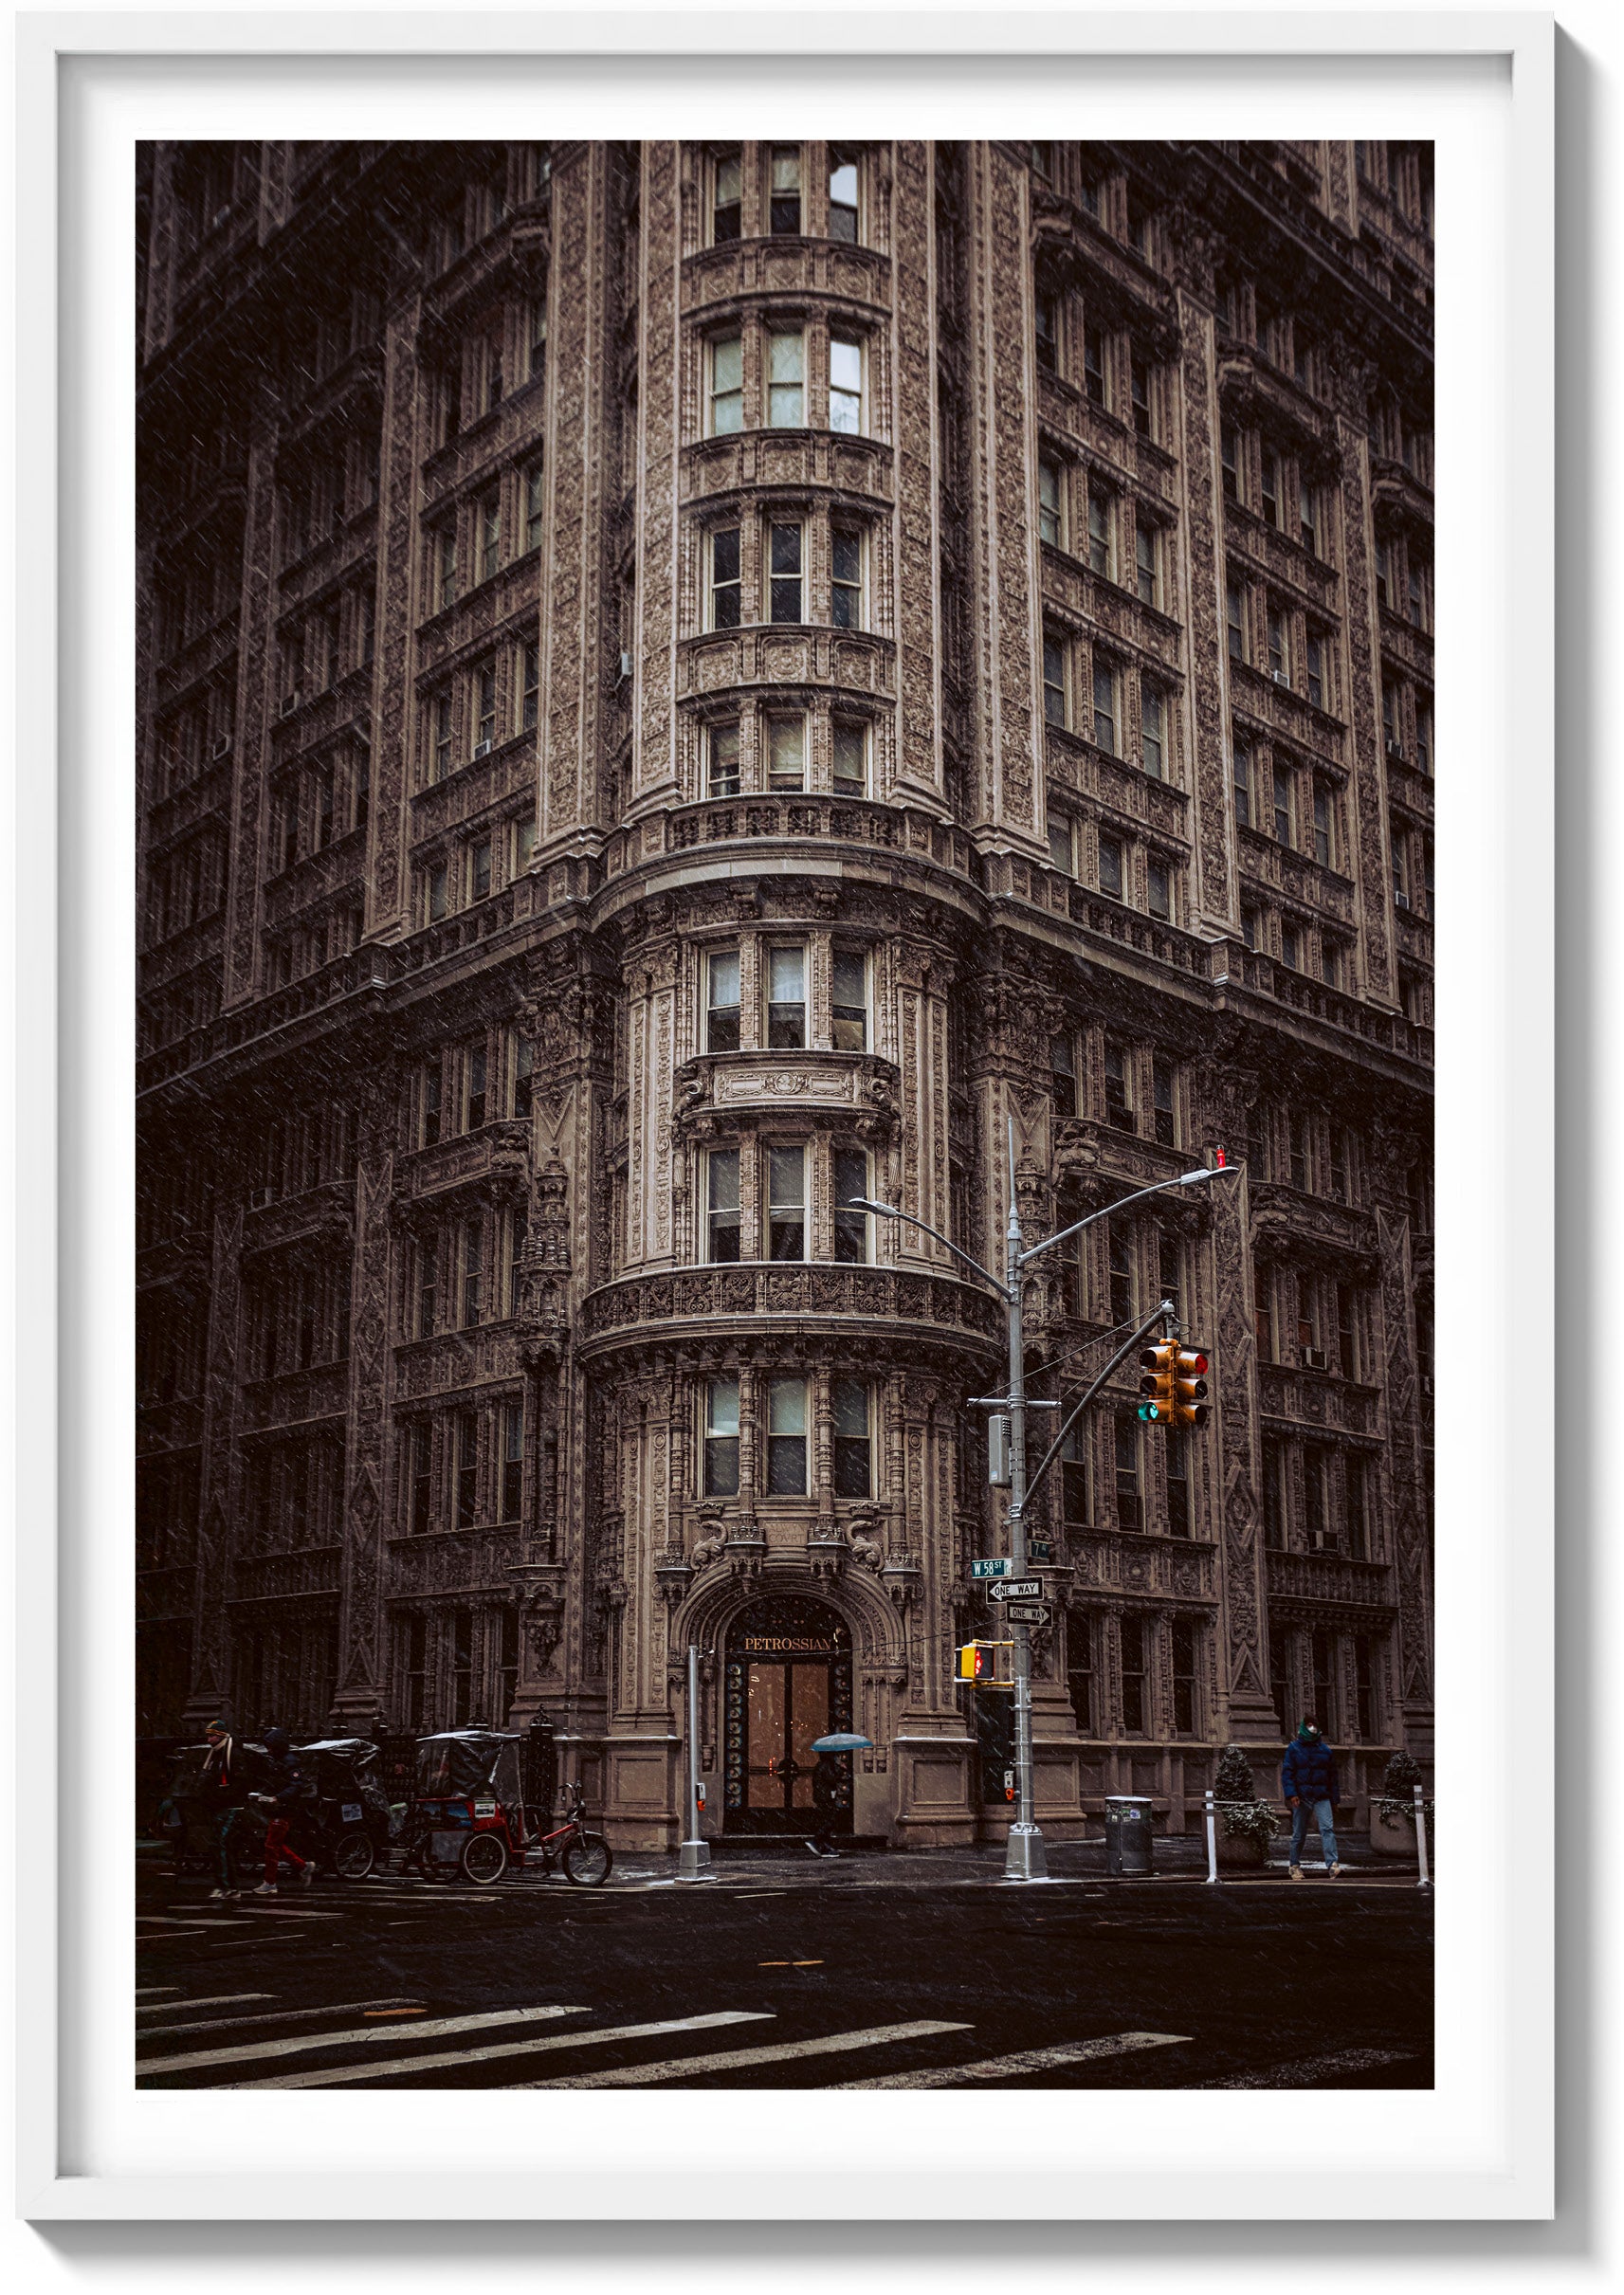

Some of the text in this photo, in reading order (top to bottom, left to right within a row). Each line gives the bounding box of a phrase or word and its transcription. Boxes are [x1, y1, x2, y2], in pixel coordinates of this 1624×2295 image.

[974, 1562, 981, 1576] W
[983, 1561, 994, 1576] 58
[994, 1584, 1035, 1595] ONE WAY
[1013, 1608, 1046, 1619] ONE WAY
[744, 1637, 831, 1650] PETROSSIAN
